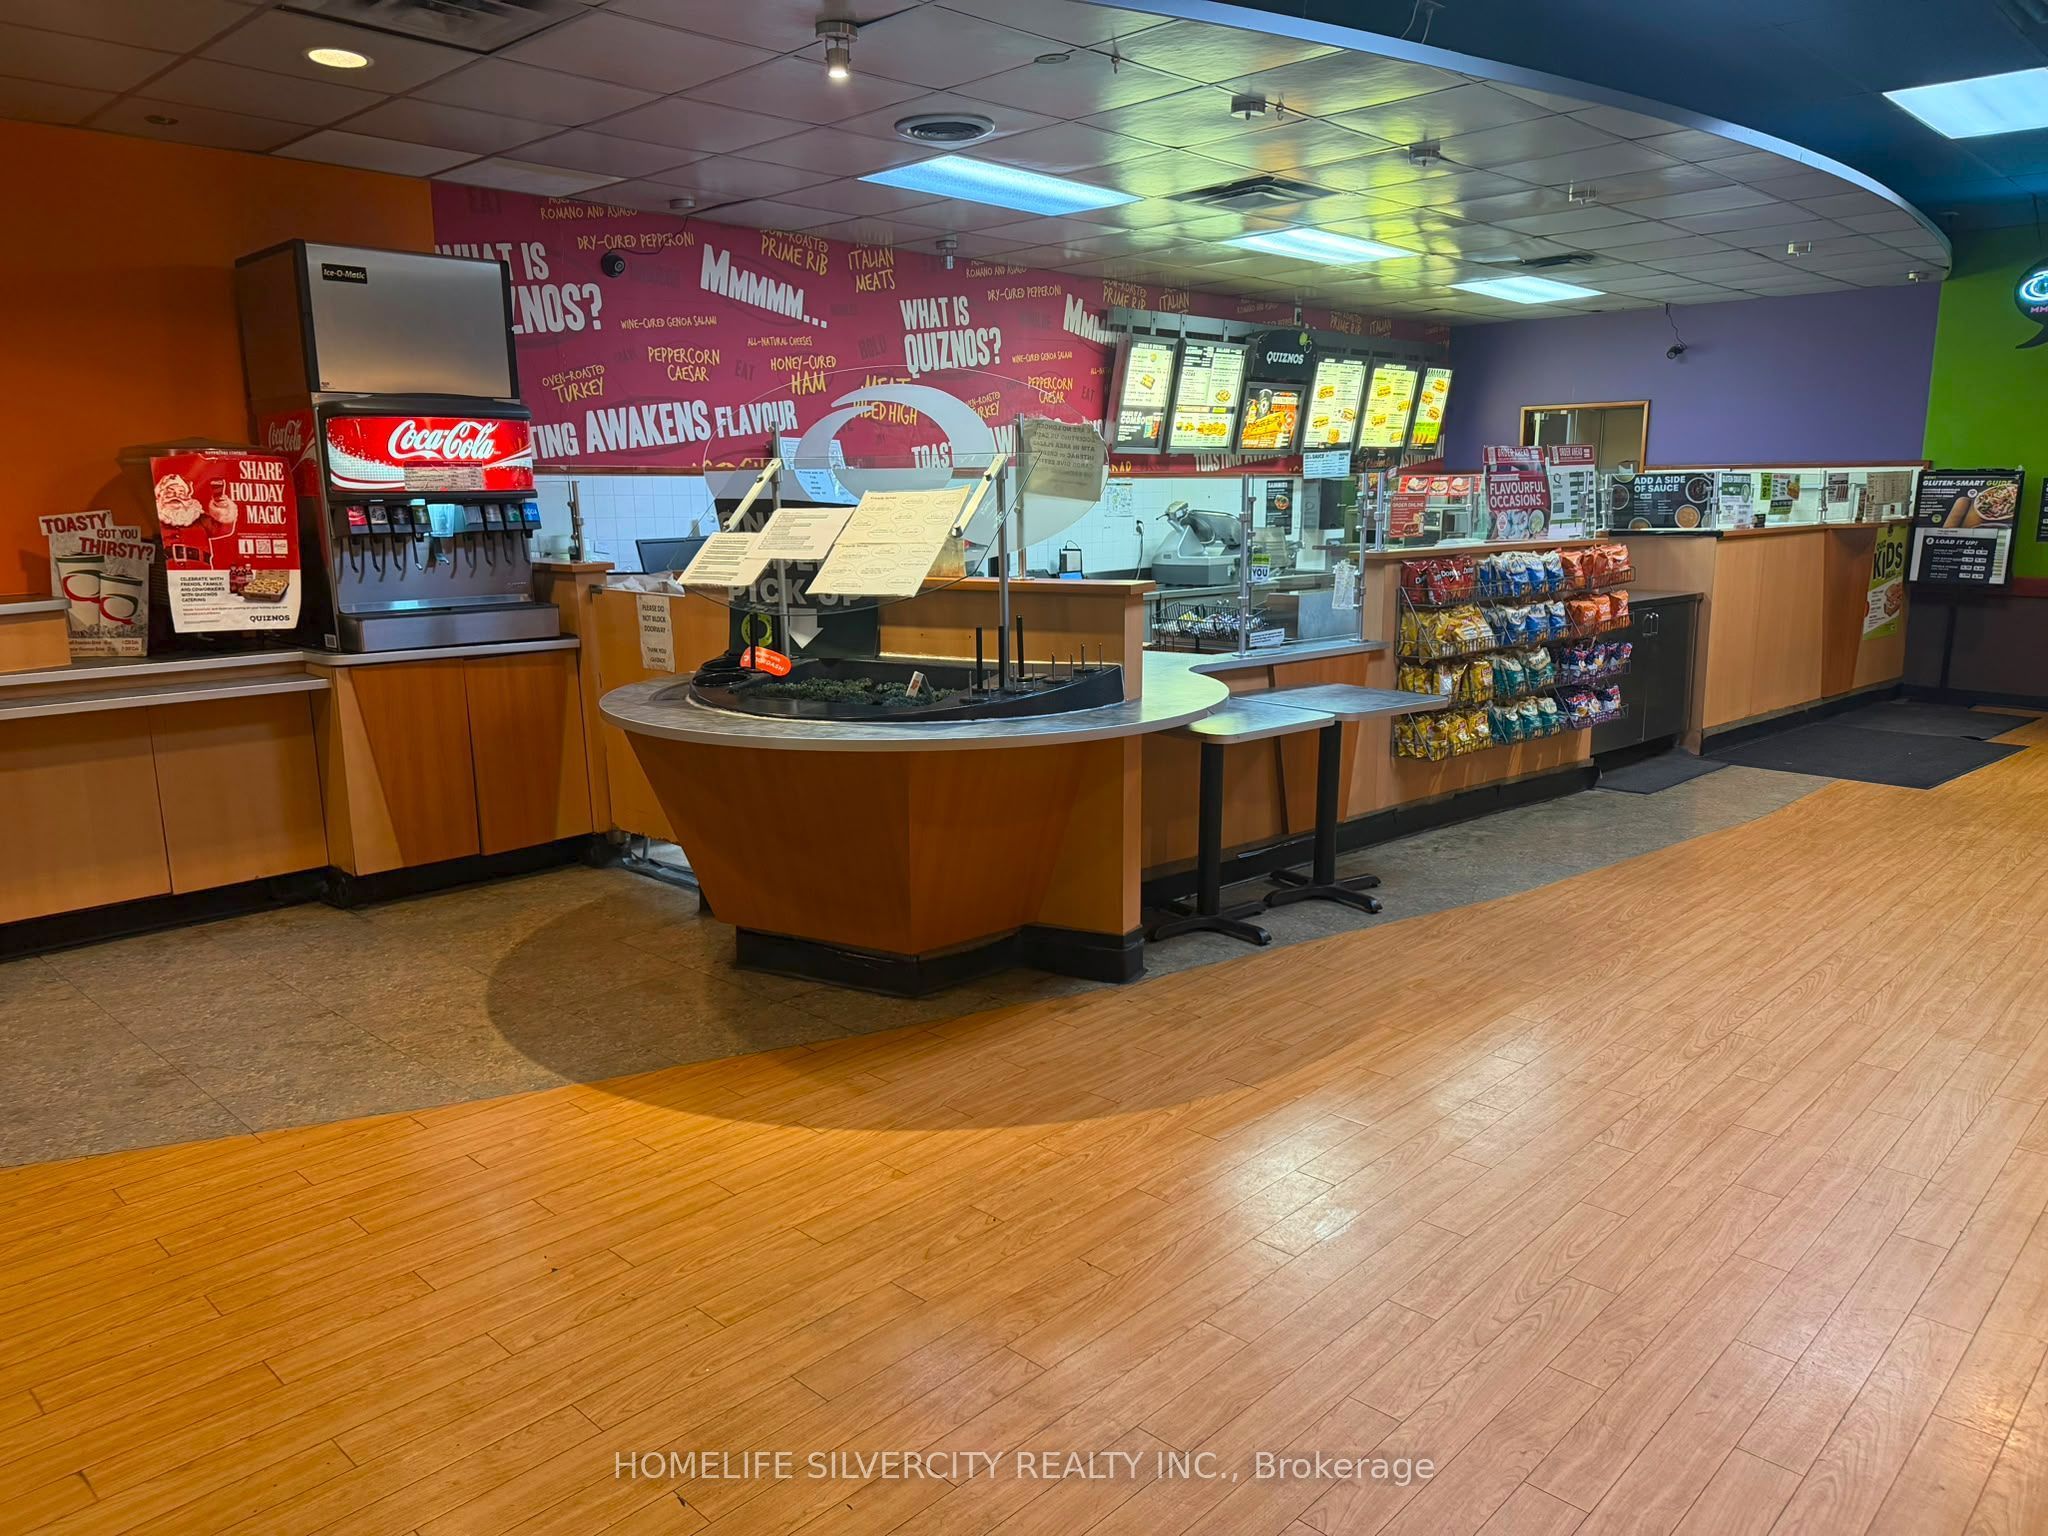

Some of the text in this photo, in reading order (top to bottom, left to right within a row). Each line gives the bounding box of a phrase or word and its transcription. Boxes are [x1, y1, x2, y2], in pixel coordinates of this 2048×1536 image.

[541, 207, 584, 220] ROMANO
[587, 206, 604, 218] AND
[577, 231, 695, 251] DRY-CURED PEPPERONI
[521, 241, 550, 281] IS
[761, 235, 829, 276] PRIME RIB
[848, 248, 894, 271] ITALIAN
[323, 268, 366, 280] Ice-O-Matic
[855, 269, 896, 294] MEATS
[966, 268, 993, 279] ROMANO
[994, 266, 1006, 276] AND
[987, 284, 1063, 302] DRY-CURED PEPPERONI
[1103, 287, 1128, 308] PRIME
[1159, 292, 1190, 313] ITALIAN
[620, 315, 717, 331] WINE-CURED GENOA SALAMI
[900, 295, 970, 331] WHAT IS
[747, 335, 813, 347] ALL-NATURAL CHEESES
[647, 346, 720, 365] PEPPERCORN
[904, 327, 1001, 379] QUIZNOS?
[1266, 351, 1305, 365] QUIZNOS
[667, 364, 709, 382] CAESAR
[770, 355, 837, 372] HONEY-CURED
[542, 365, 605, 387] OVEN-ROASTED
[791, 371, 827, 395] HAM
[1027, 375, 1073, 390] PEPPERCORN
[552, 379, 604, 404] TURKEY
[1038, 391, 1065, 404] CAESAR
[888, 401, 918, 426] HIGH
[585, 400, 708, 454] AWAKENS
[713, 400, 798, 438] FLAVOUR
[388, 419, 500, 460] Coca-Cola
[239, 460, 284, 481] SHARE
[1634, 475, 1686, 485] ADD A SIDE
[229, 482, 284, 503] HOLIDAY
[1489, 481, 1546, 495] FLAVOURFUL
[1634, 484, 1679, 493] OF SAUCE
[1490, 494, 1545, 508] OCCASIONS.
[42, 513, 107, 535] TOASTY
[246, 505, 287, 525] MAGIC
[97, 529, 138, 540] GOT YOU
[79, 537, 154, 562] THIRSTY?
[1873, 542, 1904, 580] KIDS
[1252, 568, 1268, 577] YOU
[730, 577, 809, 609] PICK
[249, 614, 290, 623] QUIZNOS
[642, 604, 665, 613] PLEASE DO
[642, 615, 666, 624] NOT BLOCK
